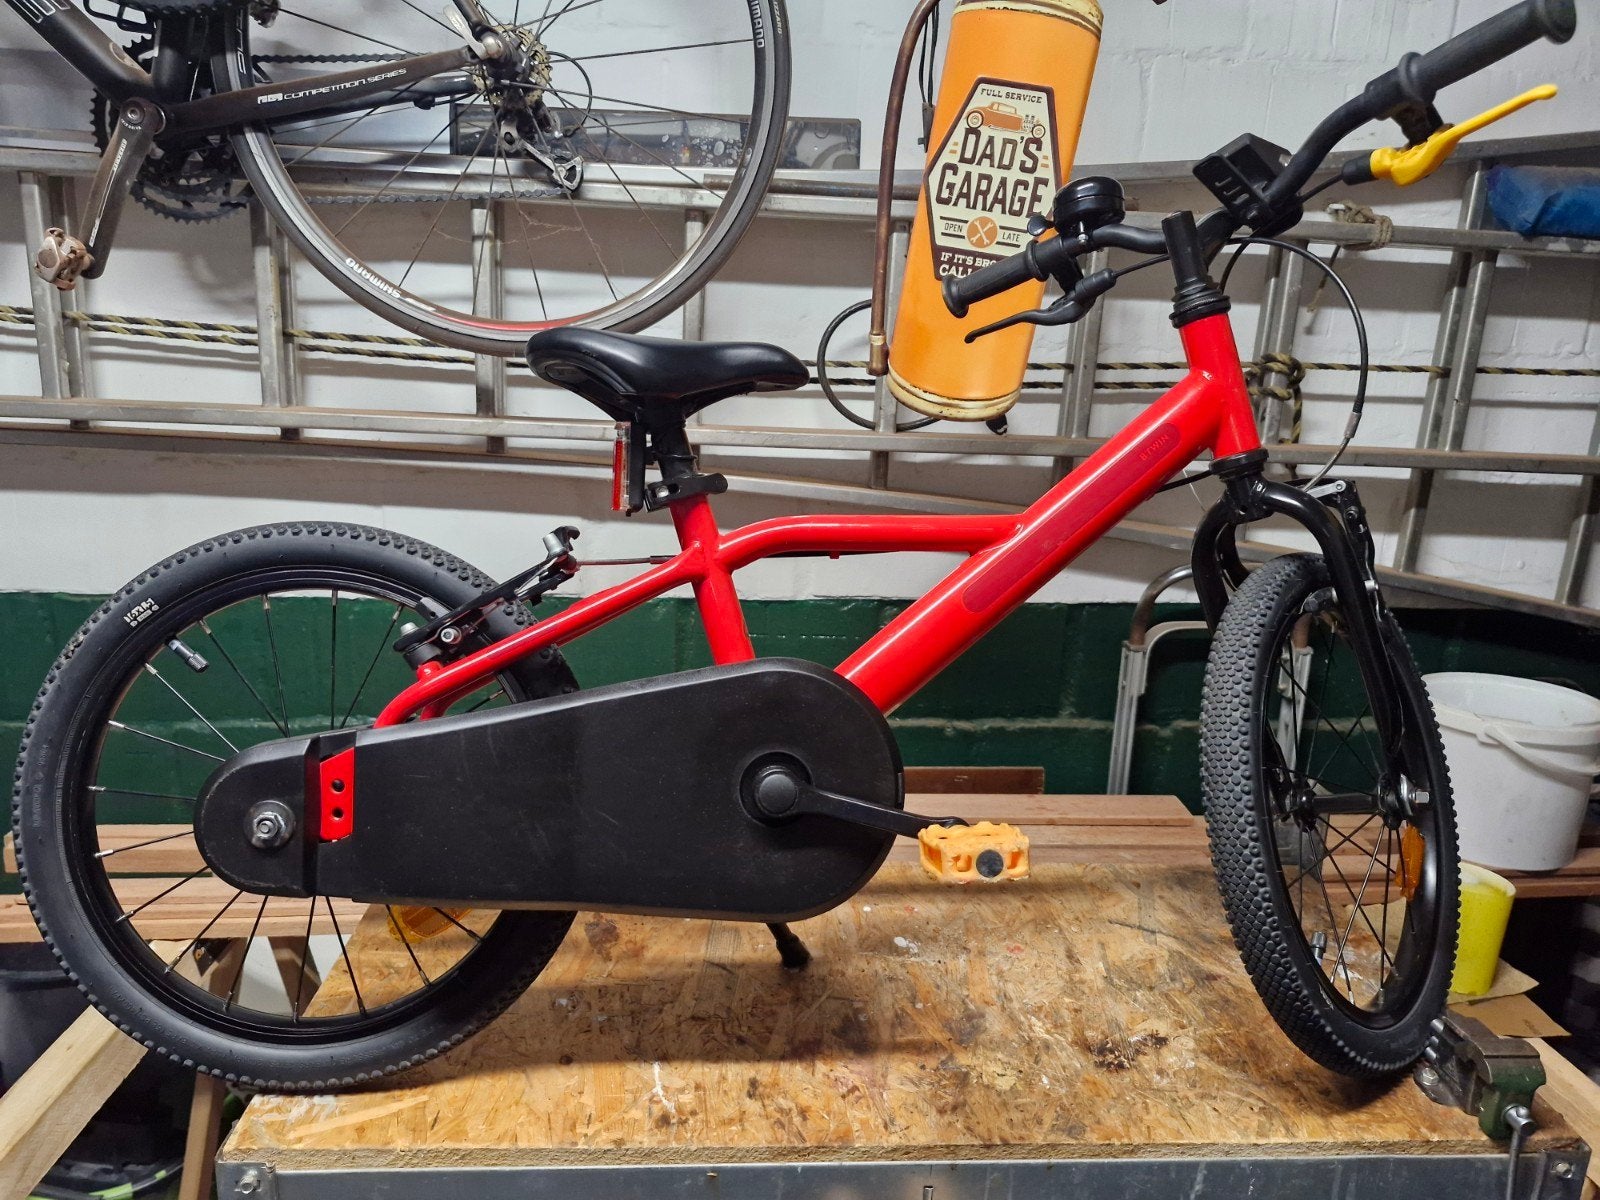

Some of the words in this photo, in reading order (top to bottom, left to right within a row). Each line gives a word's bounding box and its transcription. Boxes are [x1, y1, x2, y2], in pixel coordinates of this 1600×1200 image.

[751, 0, 765, 48] IMANO
[284, 78, 366, 100] COMPETITION
[367, 68, 407, 83] SERIES
[981, 88, 1003, 98] FULL
[1005, 91, 1042, 104] SERVICE
[958, 127, 1043, 174] DAD'S
[935, 162, 1049, 218] GARAGE
[944, 222, 963, 233] OPEN
[1002, 231, 1020, 242] LATE
[940, 251, 952, 261] IF
[953, 254, 973, 266] IT'S
[345, 257, 402, 299] SHIMANO
